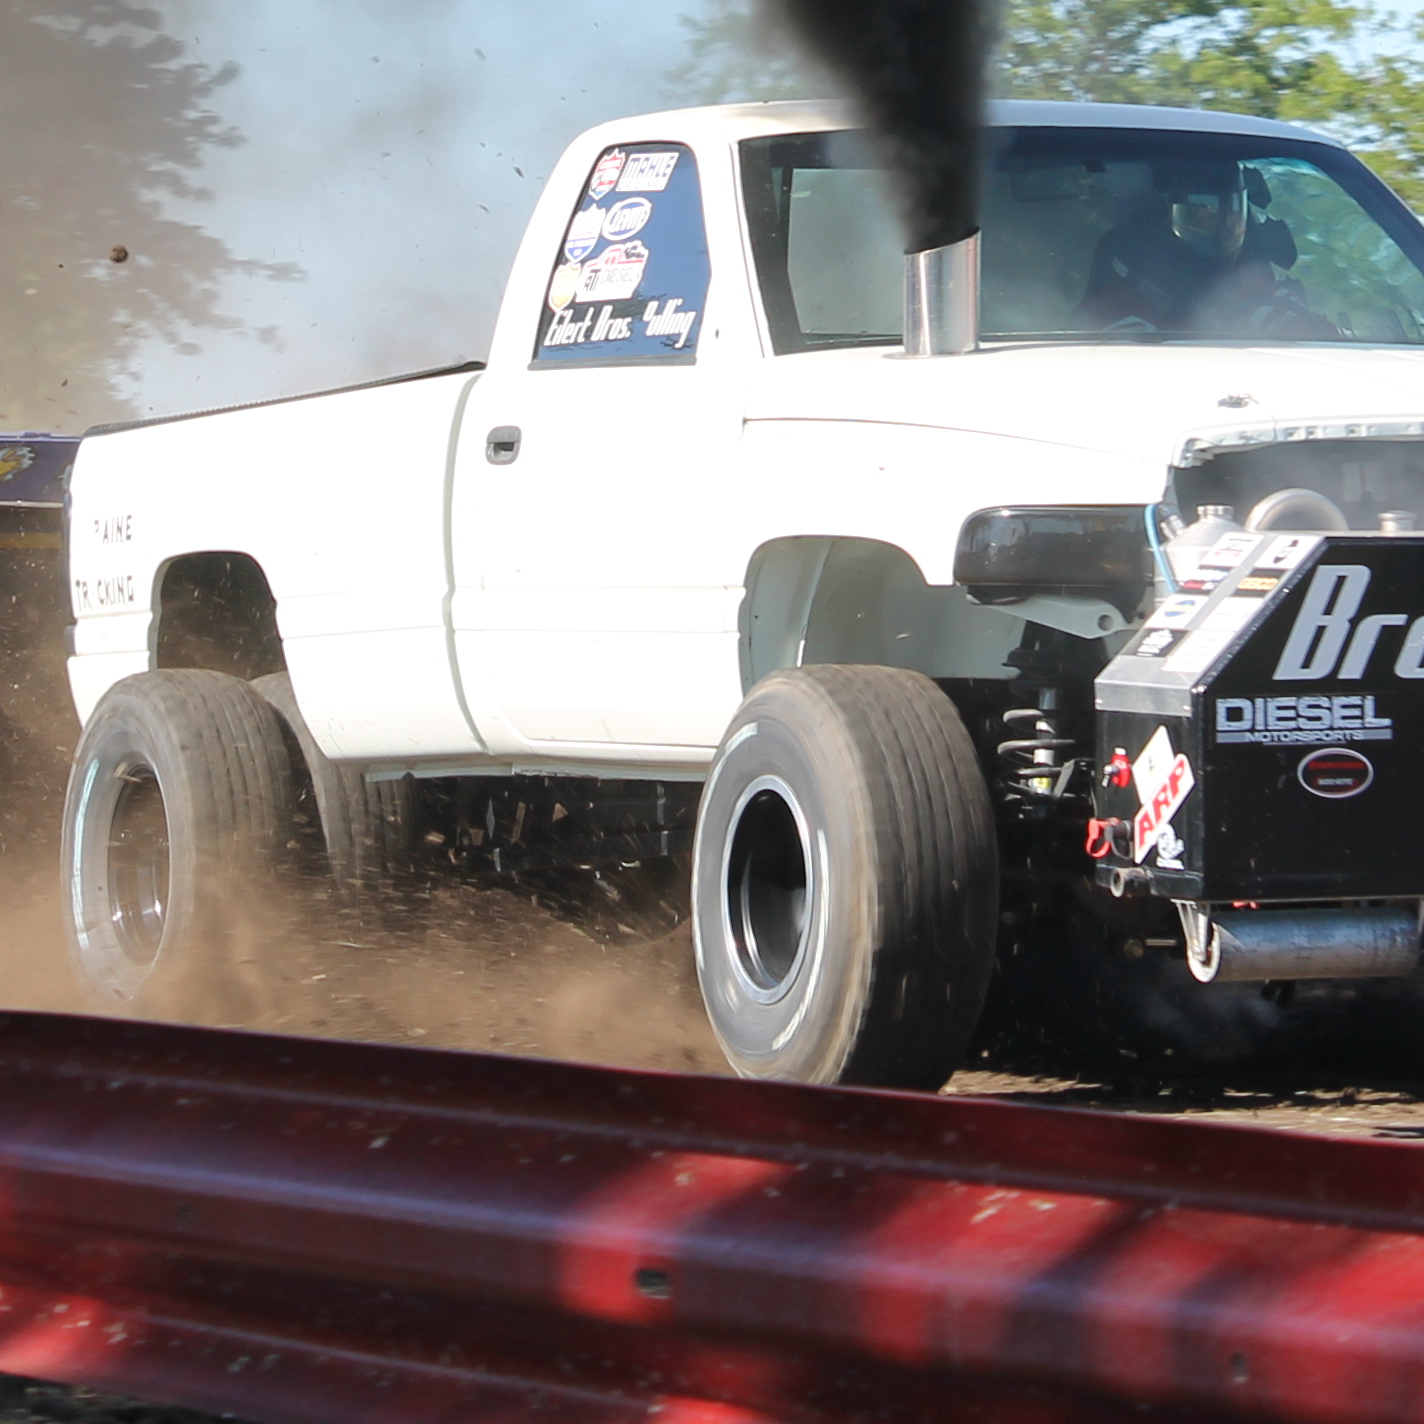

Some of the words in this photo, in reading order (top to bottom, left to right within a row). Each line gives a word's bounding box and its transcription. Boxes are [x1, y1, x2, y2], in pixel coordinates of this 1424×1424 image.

[542, 307, 594, 347] Eilert
[591, 304, 633, 343] Bros.
[642, 298, 697, 349] Pulling
[75, 574, 136, 612] TRCKING
[1215, 695, 1393, 732] DIESEL
[1244, 728, 1365, 744] MOTORSPORTS
[1138, 757, 1186, 852] ARP
